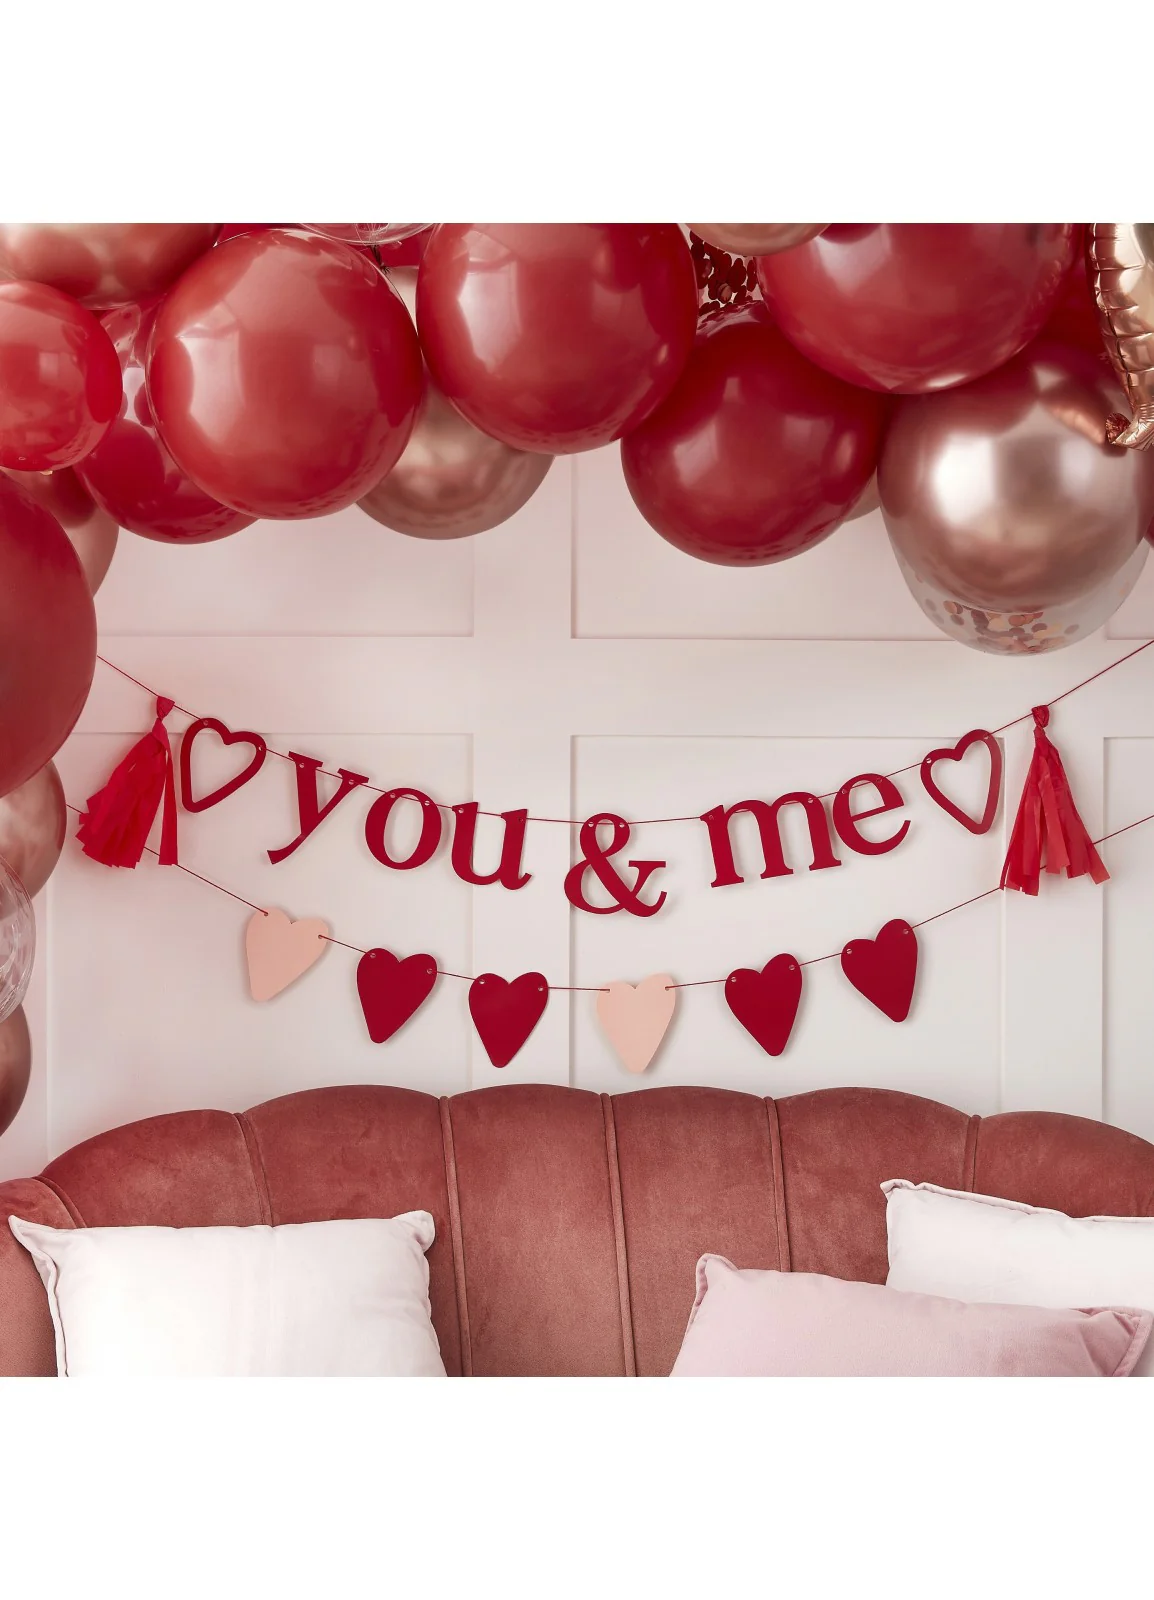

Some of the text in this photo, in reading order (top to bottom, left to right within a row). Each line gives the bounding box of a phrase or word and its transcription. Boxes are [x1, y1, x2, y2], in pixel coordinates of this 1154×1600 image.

[267, 751, 911, 917] you & me
